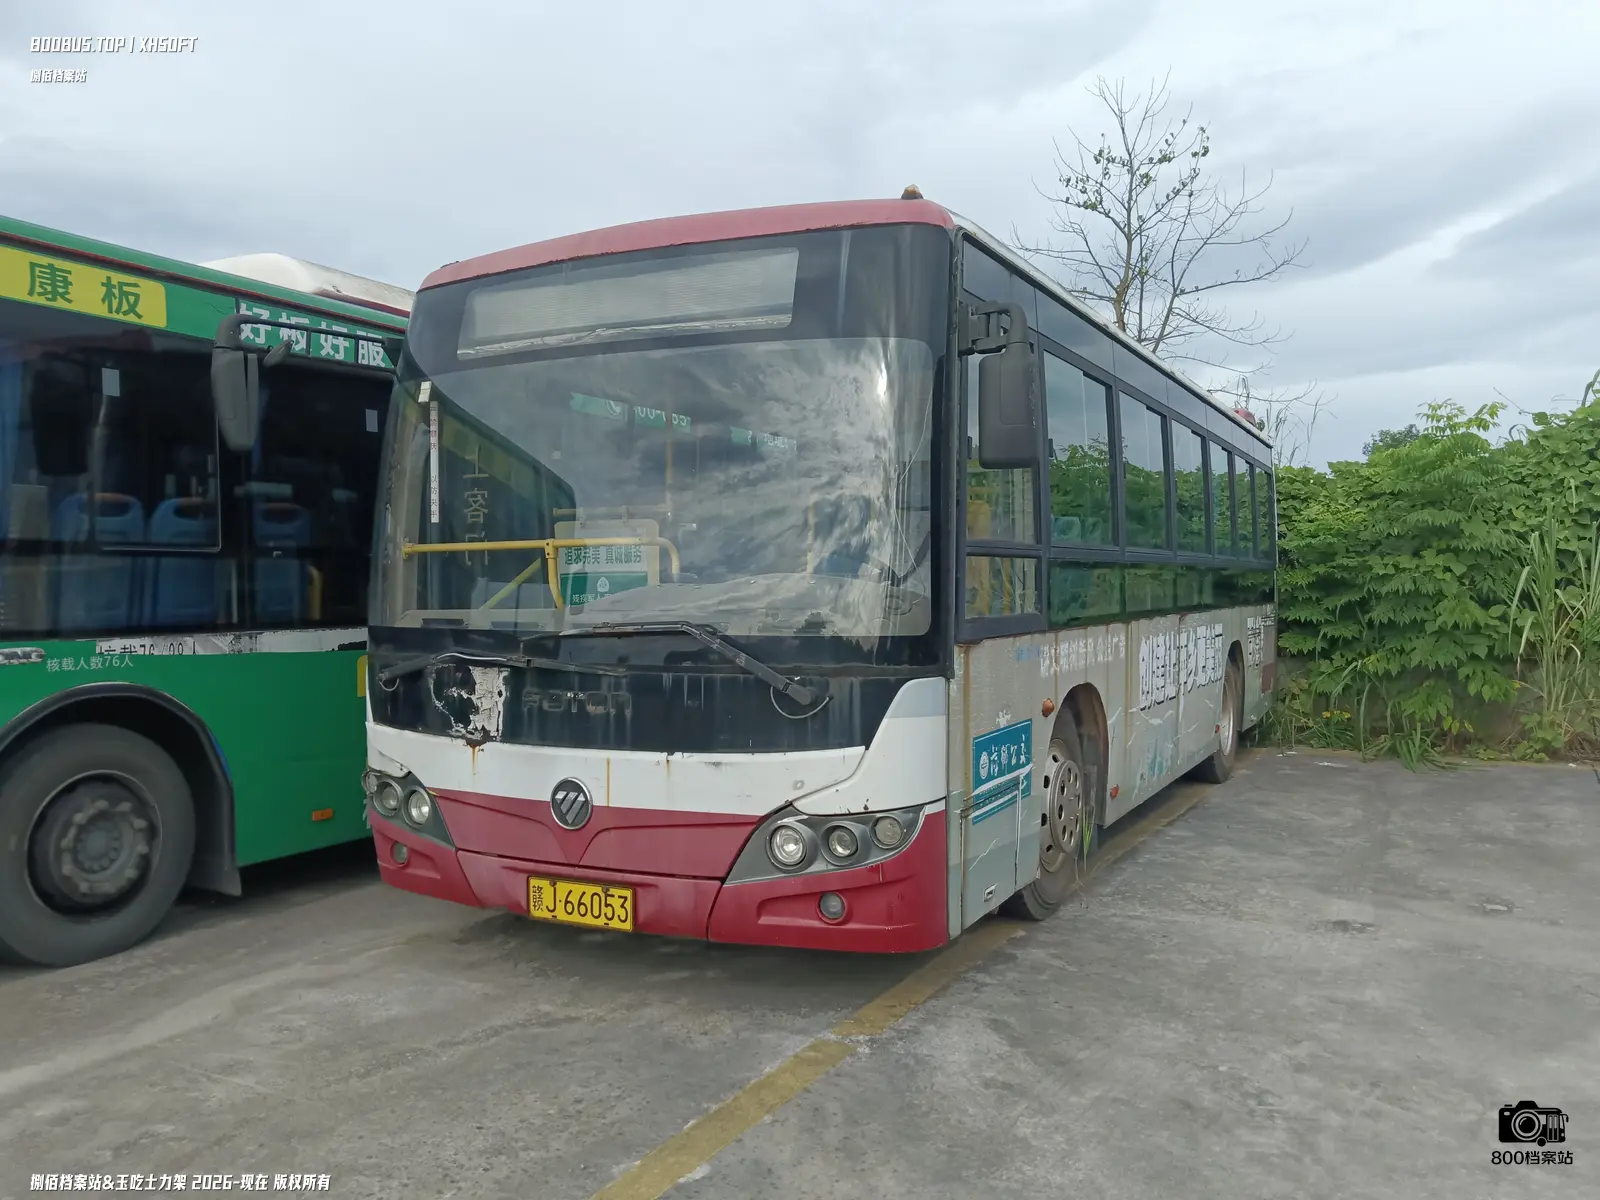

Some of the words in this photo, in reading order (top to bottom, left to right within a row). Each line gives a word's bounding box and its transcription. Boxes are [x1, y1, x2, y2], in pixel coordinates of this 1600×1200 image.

[27, 261, 144, 320] 康板
[46, 655, 134, 673] 核载人数76人
